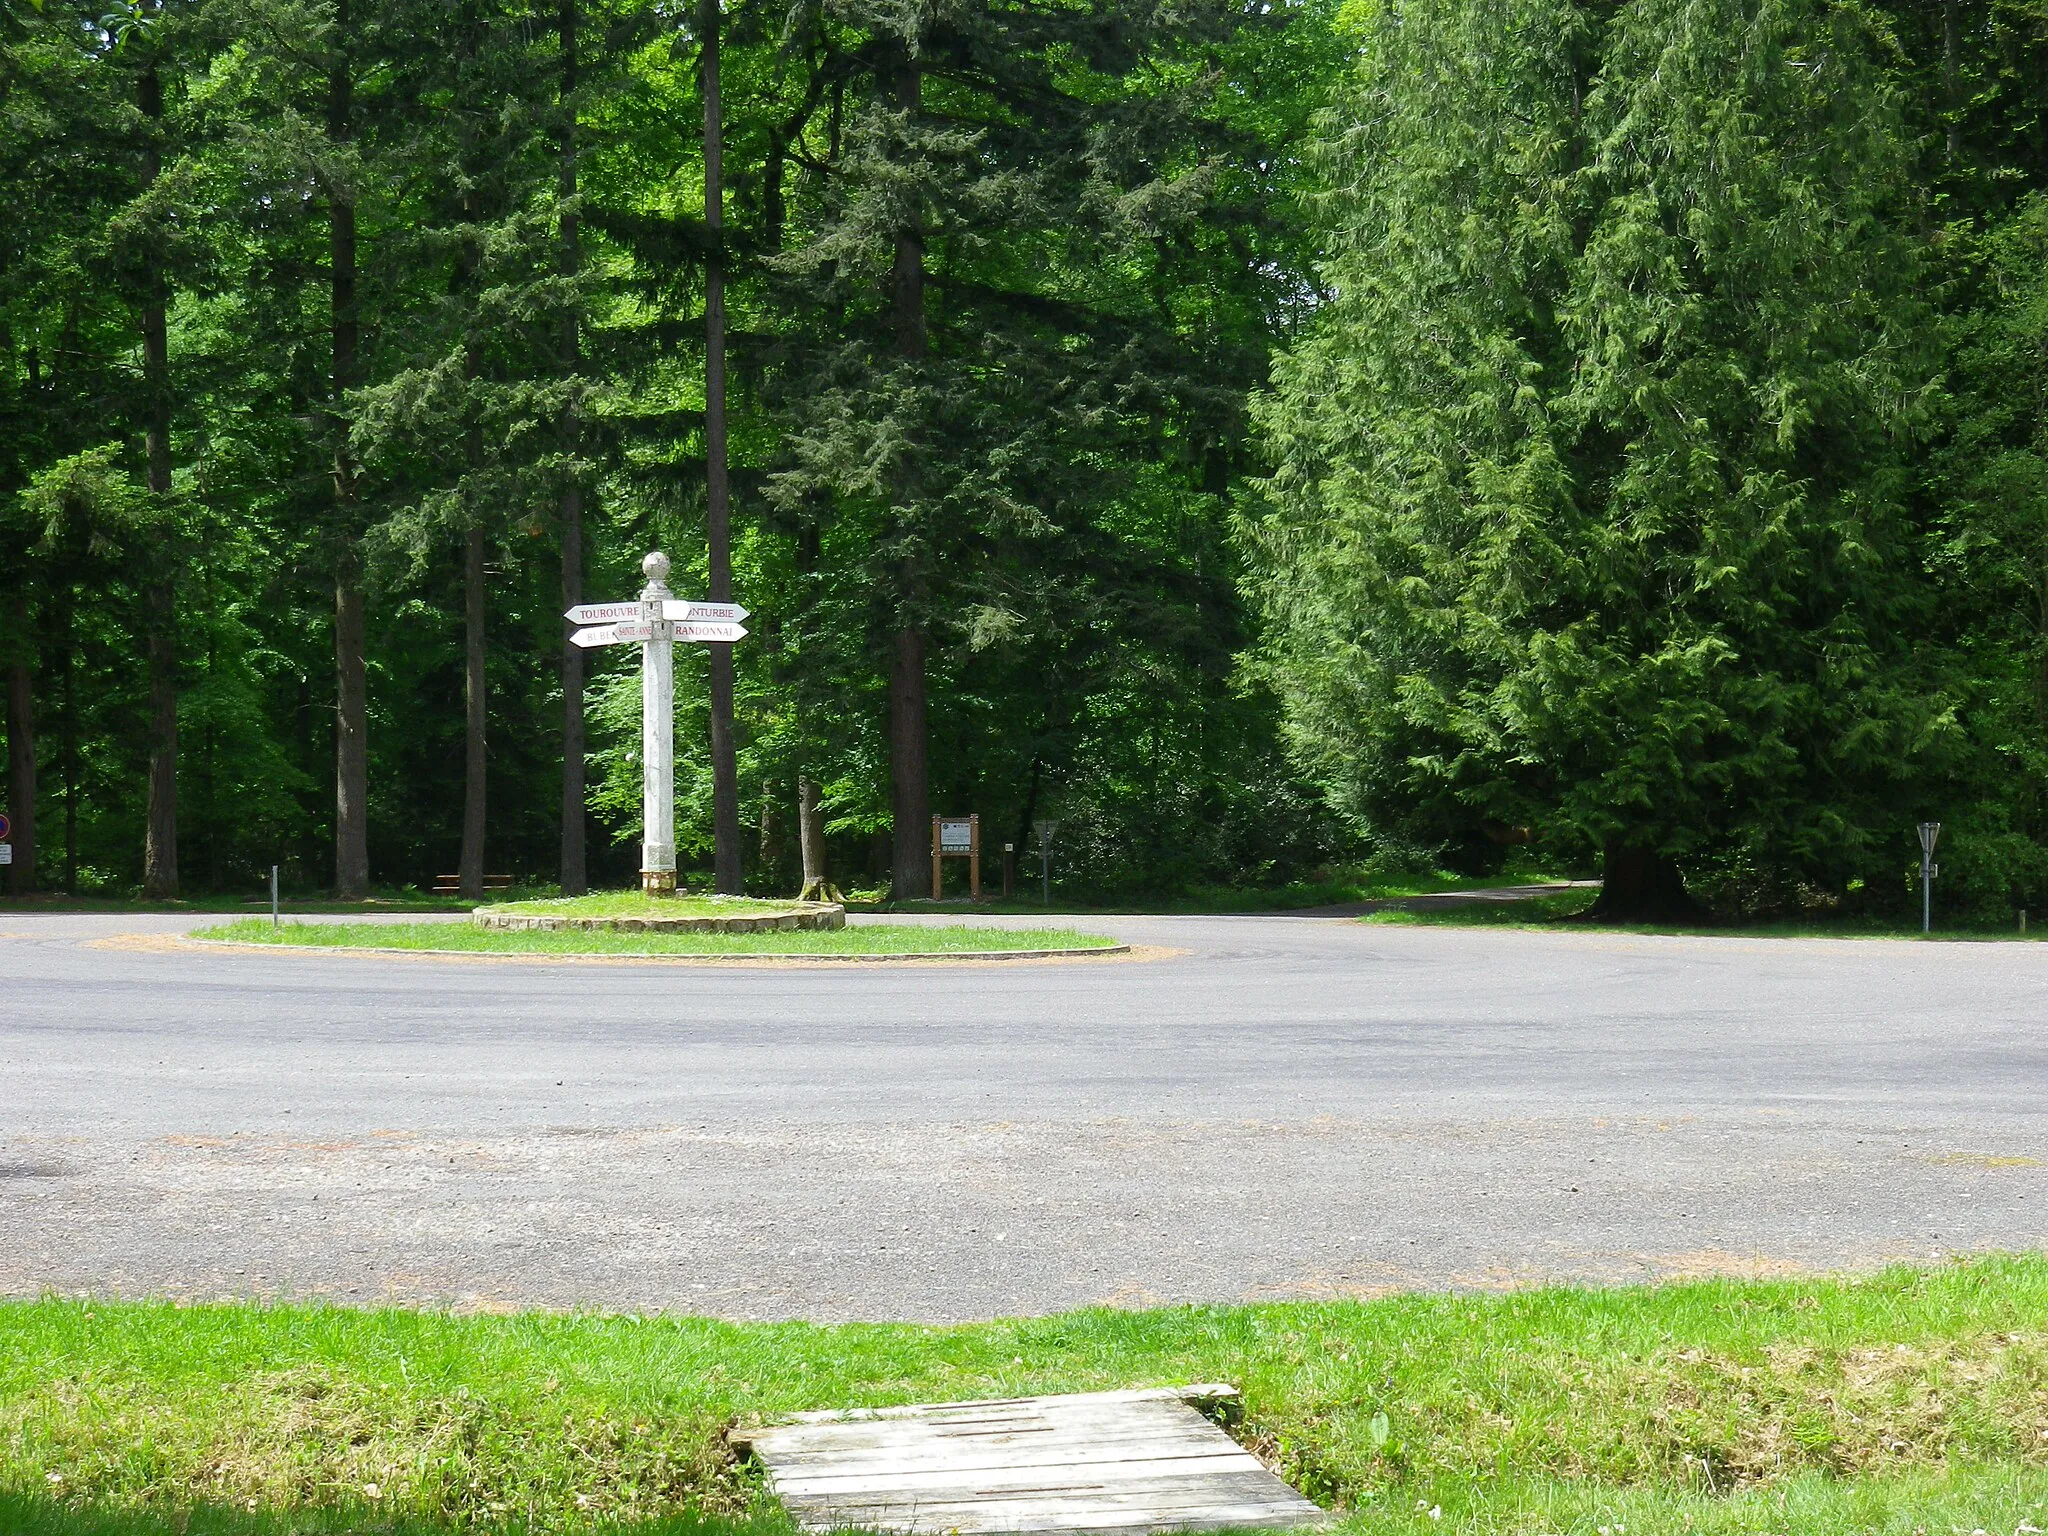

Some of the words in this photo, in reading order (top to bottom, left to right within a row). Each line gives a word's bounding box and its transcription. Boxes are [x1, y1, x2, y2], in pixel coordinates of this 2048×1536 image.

[580, 607, 639, 619] TOUROUVRE
[690, 607, 734, 618] NTURBIE
[676, 626, 732, 636] RANDONNAI
